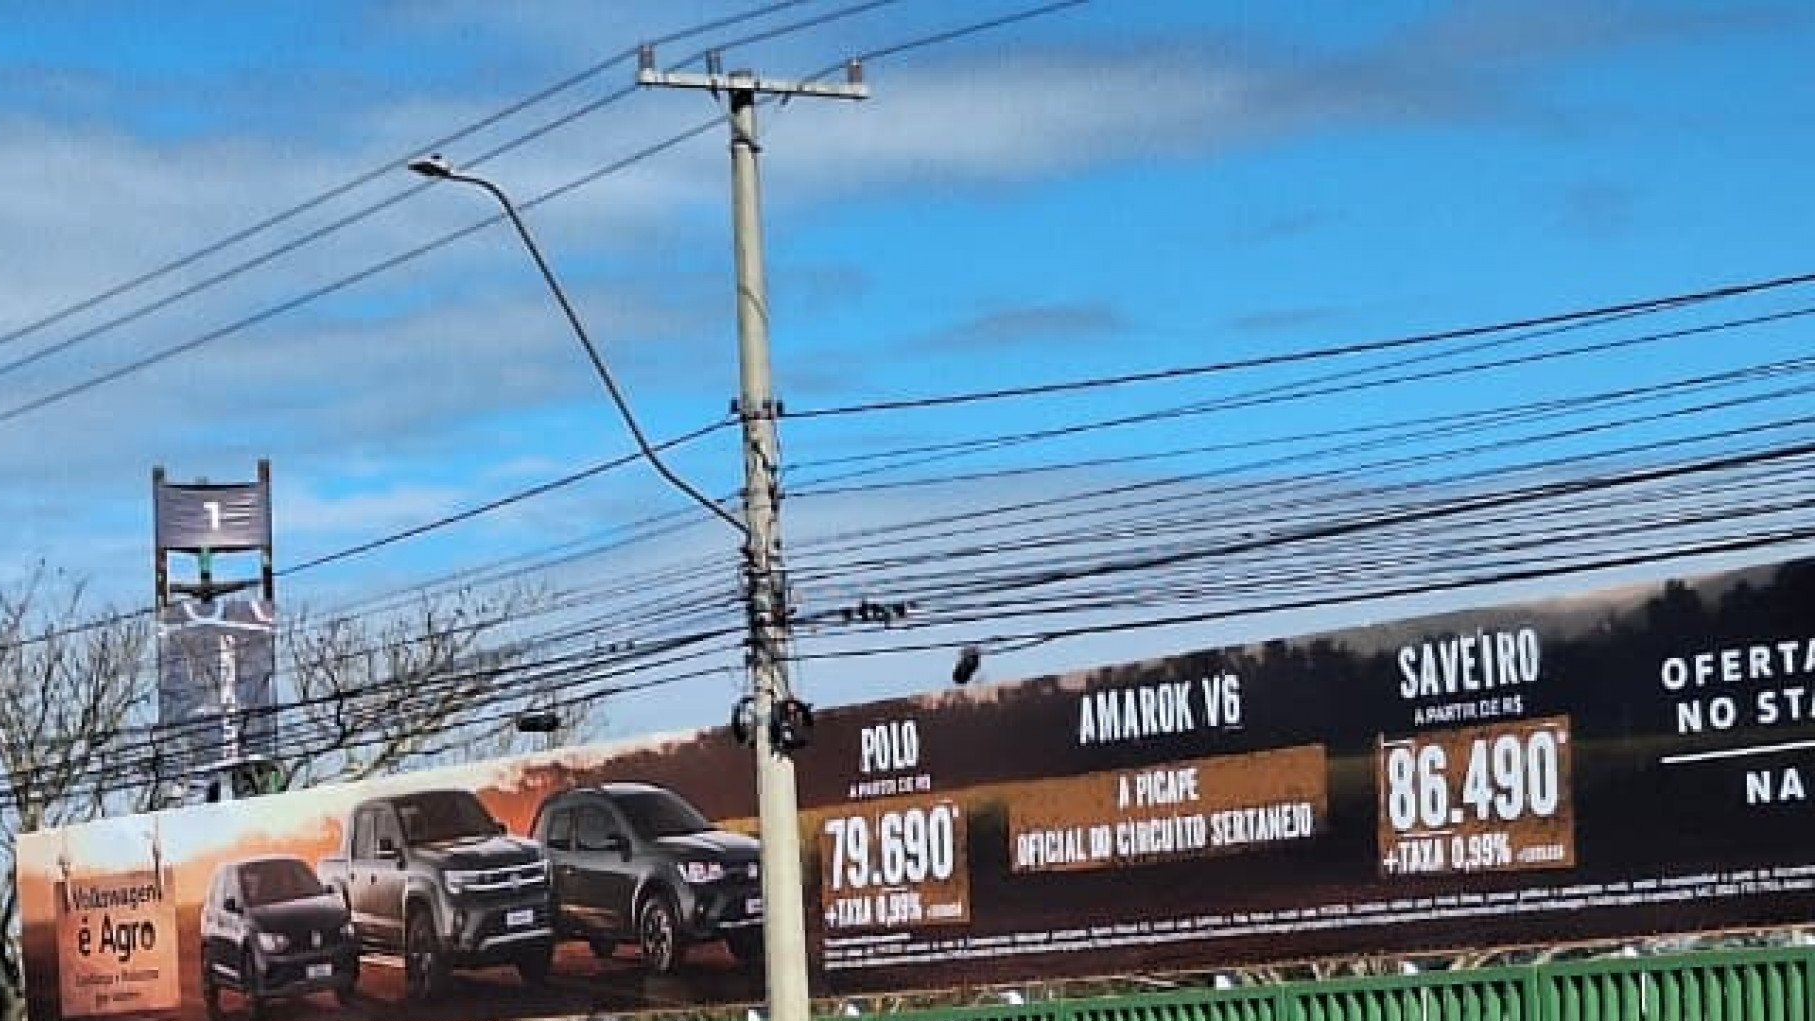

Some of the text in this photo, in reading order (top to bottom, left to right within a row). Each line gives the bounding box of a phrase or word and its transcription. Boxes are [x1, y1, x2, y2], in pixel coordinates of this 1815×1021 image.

[204, 501, 220, 531] 1
[1398, 627, 1541, 699] SAVEIRO
[1079, 673, 1240, 746] AMAROK V6
[1678, 685, 1815, 734] NO ST
[860, 719, 919, 773] POLO
[1119, 768, 1200, 810] A PICAPE
[1388, 731, 1558, 831] 86.490
[1746, 766, 1806, 803] NA
[824, 805, 954, 890] 79.690
[1017, 802, 1312, 866] OFICIAL DO CIRCUITO SERTANEJO
[99, 915, 156, 963] Agro
